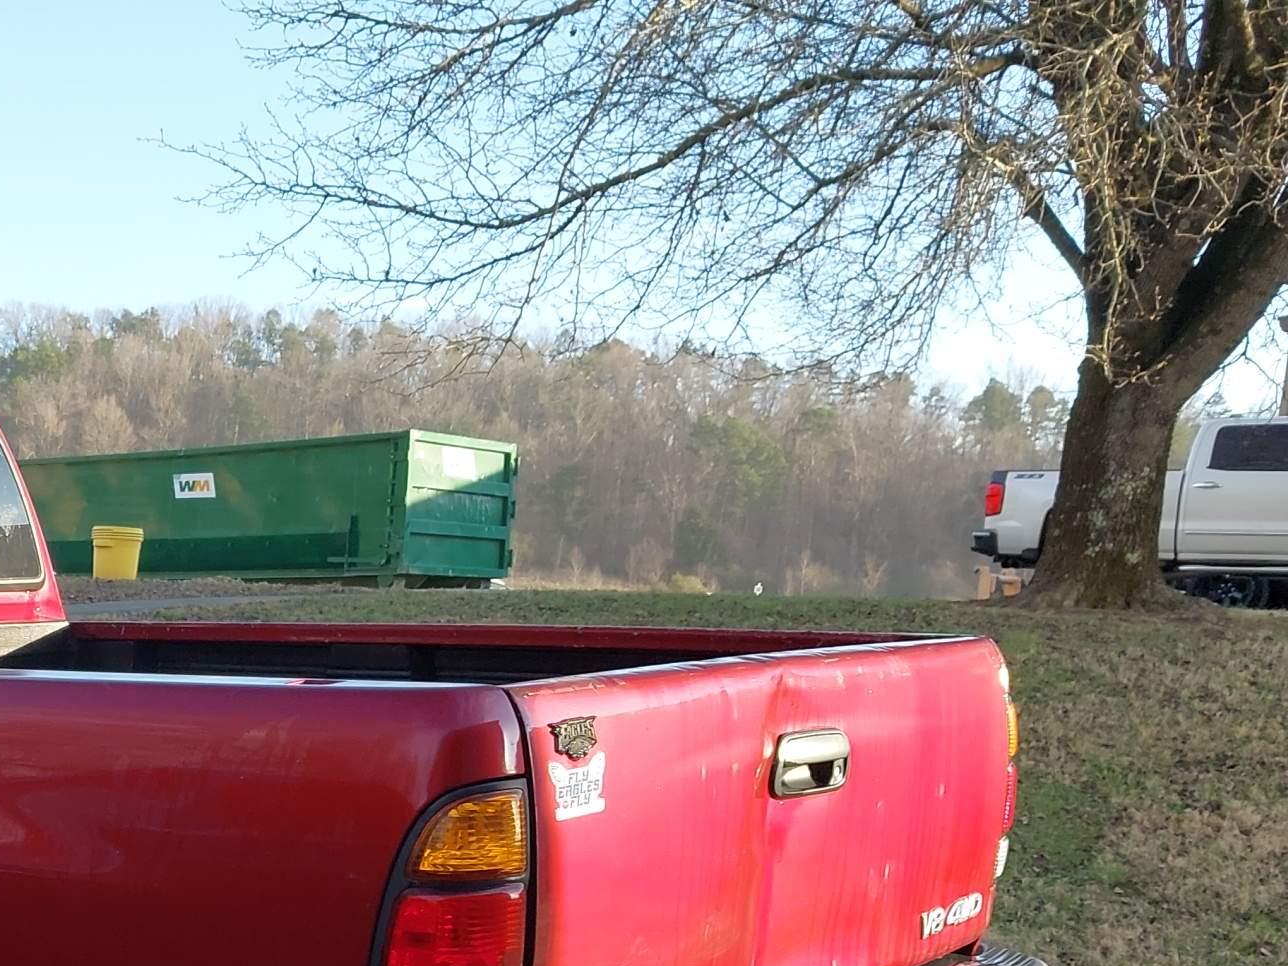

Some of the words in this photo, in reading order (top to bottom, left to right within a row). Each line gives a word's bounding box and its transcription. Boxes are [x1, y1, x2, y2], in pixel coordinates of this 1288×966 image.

[178, 480, 210, 492] WM
[568, 768, 590, 784] FLY
[558, 779, 600, 799] EAGLES
[570, 793, 591, 808] FLY
[920, 906, 945, 939] V8
